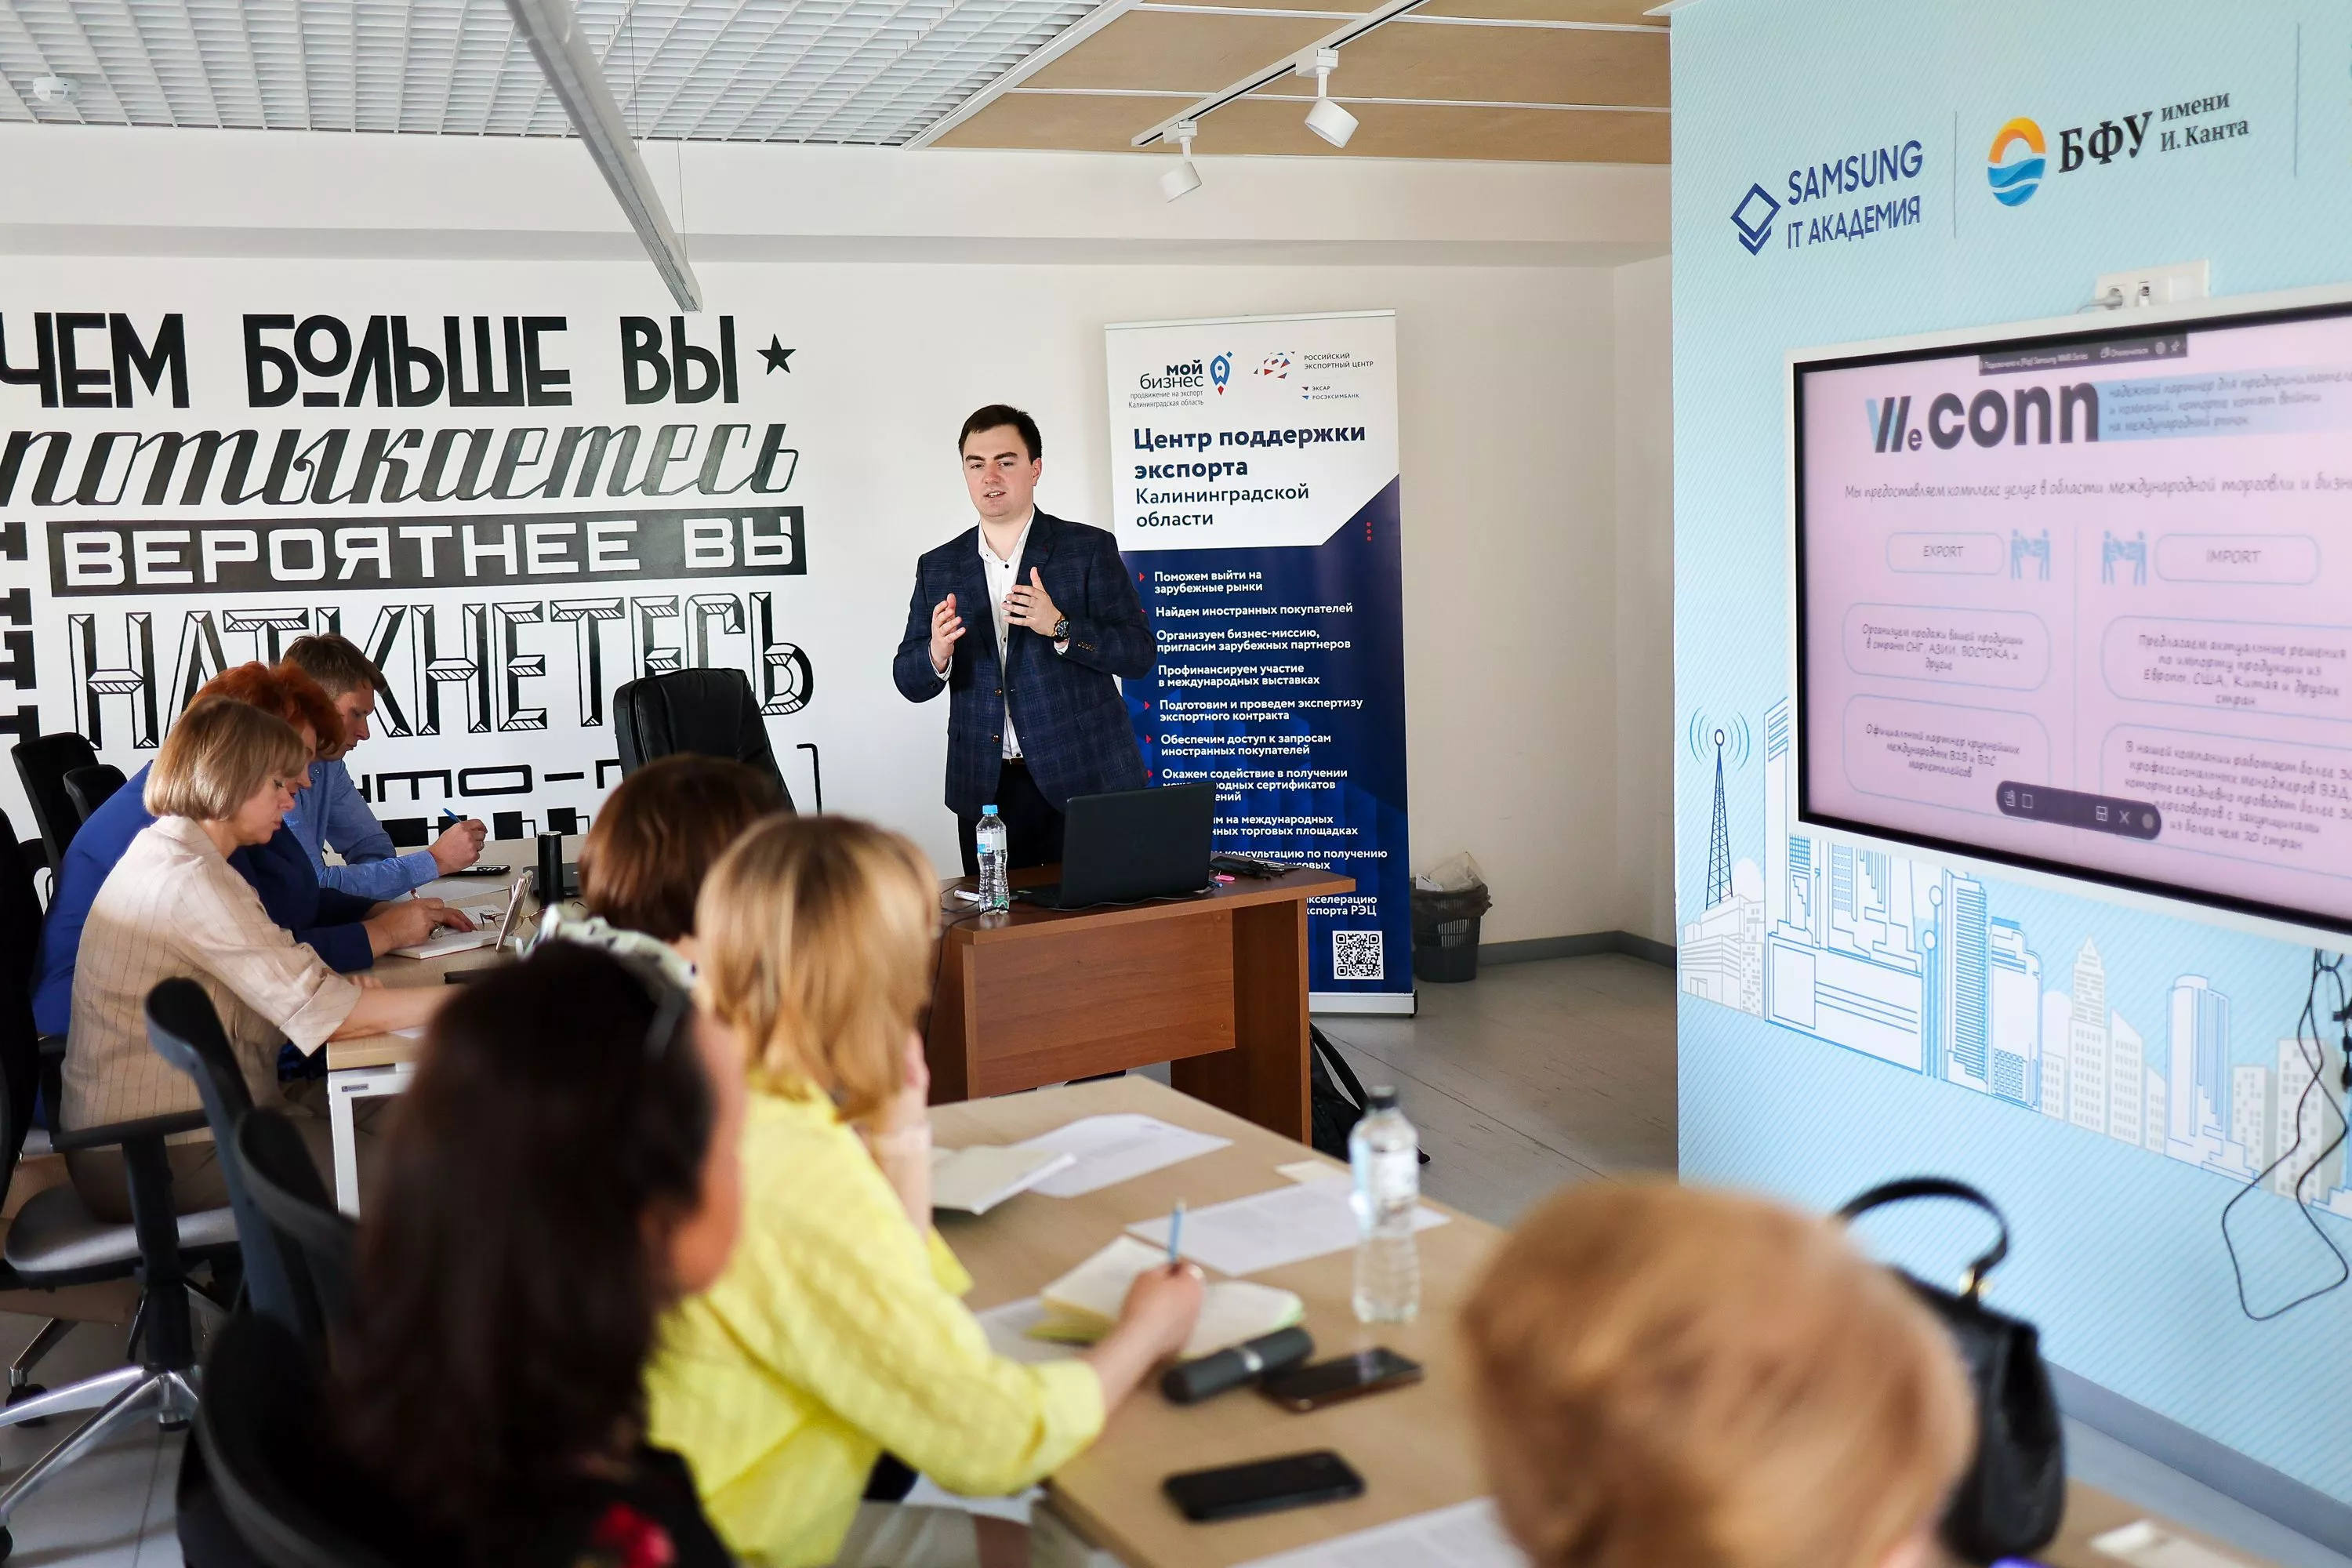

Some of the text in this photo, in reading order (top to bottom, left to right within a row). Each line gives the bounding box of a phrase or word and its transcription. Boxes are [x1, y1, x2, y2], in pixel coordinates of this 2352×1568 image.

[2161, 93, 2231, 123] имени
[2184, 118, 2250, 149] Канта
[2059, 111, 2153, 175] БФУ
[1788, 139, 1924, 206] SAMSUNG
[1788, 195, 1922, 249] IT АКАДЕМИЯ
[0, 312, 739, 408] ЧЕМ БОЛЬШЕ ВЫ
[1305, 352, 1350, 361] РОССИЙСКИЙ
[1167, 359, 1203, 376] мой
[1305, 361, 1350, 369] ЭКСПОРТНЫЙ
[1140, 373, 1203, 390] бизнес
[1131, 391, 1170, 400] продвижение
[1129, 400, 1179, 408] Калининградская
[1134, 426, 1366, 452] Центр поддержки
[1134, 461, 1248, 481] экспорта
[1136, 483, 1309, 505] Калининградской
[1845, 485, 1862, 499] Мы
[1864, 483, 1945, 502] предоставляем
[1947, 485, 2001, 499] комплекс
[2004, 485, 2036, 500] услуг
[2049, 478, 2103, 495] области
[2108, 477, 2216, 498] международной
[2222, 474, 2294, 496] торговли
[1136, 511, 1213, 528] области
[63, 516, 793, 586] ВЕРОЯТНЕЕ ВЫ
[1923, 546, 1964, 557] EXPORT
[2206, 550, 2261, 564] IMPORT
[1154, 570, 1261, 583] Поможем выйти на
[1154, 583, 1263, 595] зарубежные рынки
[1156, 603, 1353, 618] Найдем иностранных покупателей
[1156, 628, 1320, 642] Организуем бизнес-миссию,
[1156, 639, 1351, 654] пригласим зарубежных партнеров
[1962, 646, 2009, 661] ВОСТОКА
[1158, 664, 1305, 677] Профинансируем участие
[1167, 677, 1259, 688] международных
[1261, 676, 1319, 686] выставках
[1160, 699, 1228, 711] Подготовим
[1240, 699, 1295, 711] проведем
[1298, 697, 1363, 710] экспертизу
[1160, 711, 1290, 724] экспортного контракта
[1160, 734, 1225, 744] Обеспечим
[1227, 734, 1266, 746] доступ
[1278, 734, 1331, 745] запросам
[1161, 744, 1310, 757] иностранных покупателей
[1162, 768, 1207, 779] Окажем
[1210, 768, 1275, 780] содействие
[1287, 769, 1348, 780] получении
[1256, 779, 1336, 791] сертификатов
[1241, 815, 1334, 826] международных
[1240, 827, 1294, 837] торговых
[1296, 827, 1358, 837] площадках
[1323, 850, 1388, 860] получению
[1307, 895, 1377, 906] кселерацию
[1351, 905, 1377, 916] РЭЦ
